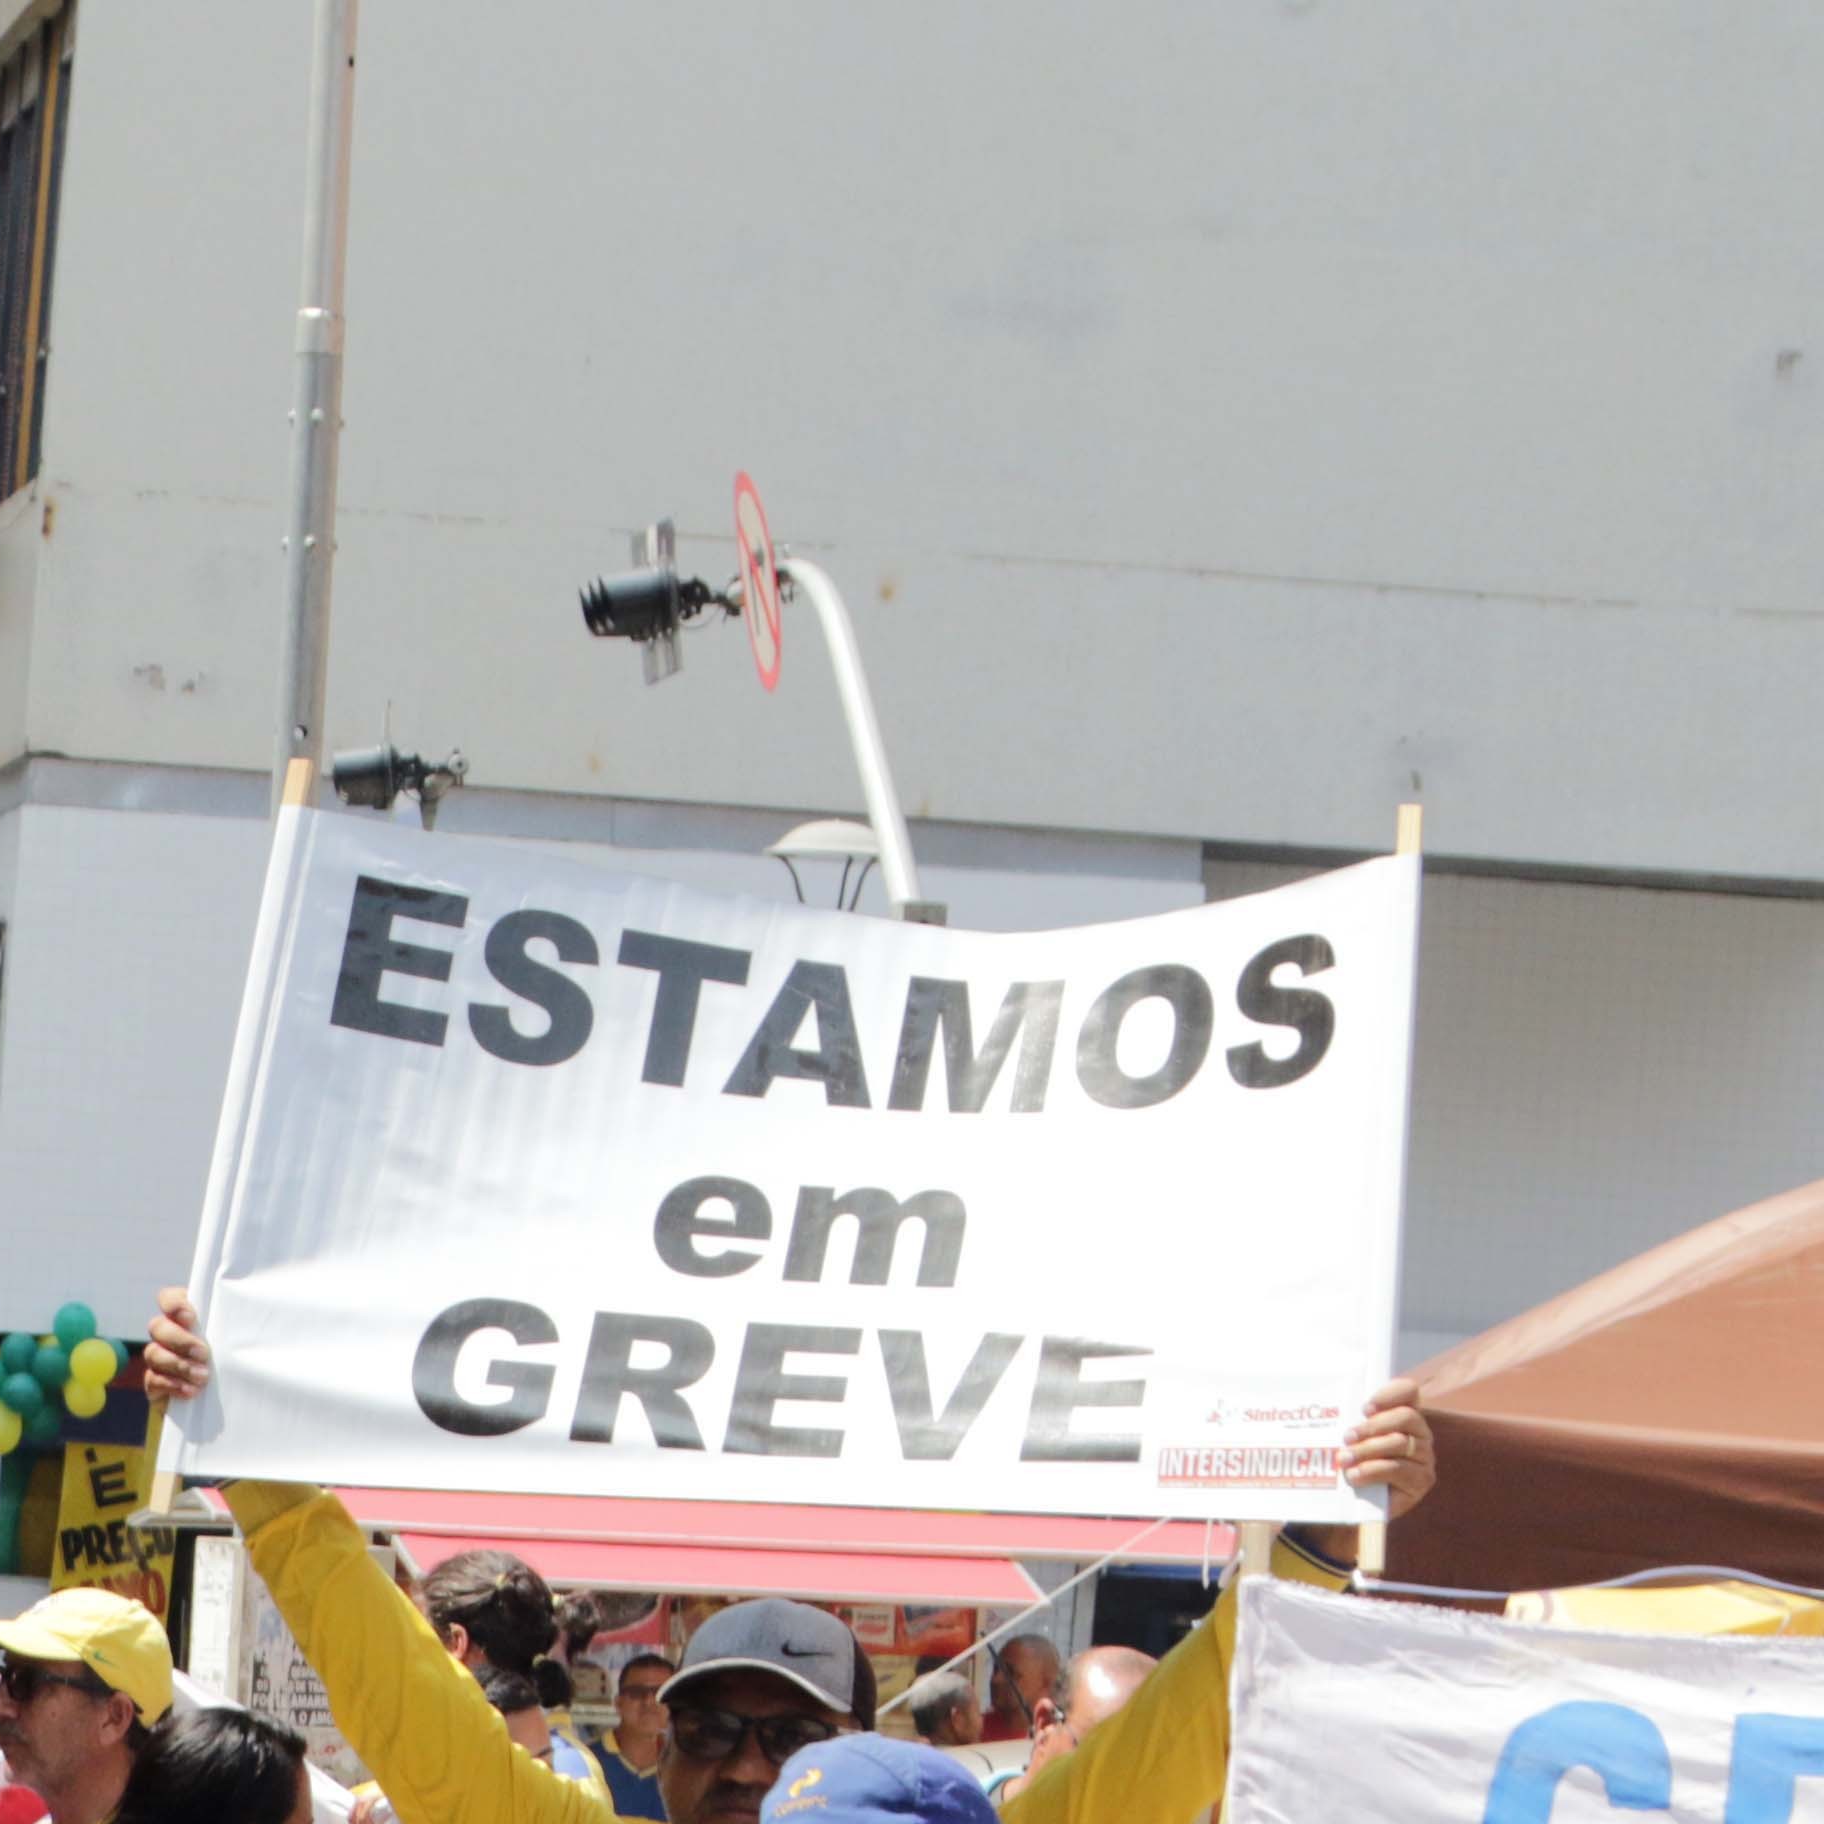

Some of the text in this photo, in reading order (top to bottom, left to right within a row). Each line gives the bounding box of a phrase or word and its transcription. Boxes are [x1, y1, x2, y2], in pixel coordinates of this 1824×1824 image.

[329, 874, 1337, 1114] ESTAMOS
[652, 1174, 968, 1289] em
[411, 1297, 1152, 1467] GREVE
[1159, 1449, 1337, 1477] INTERSINDICAL
